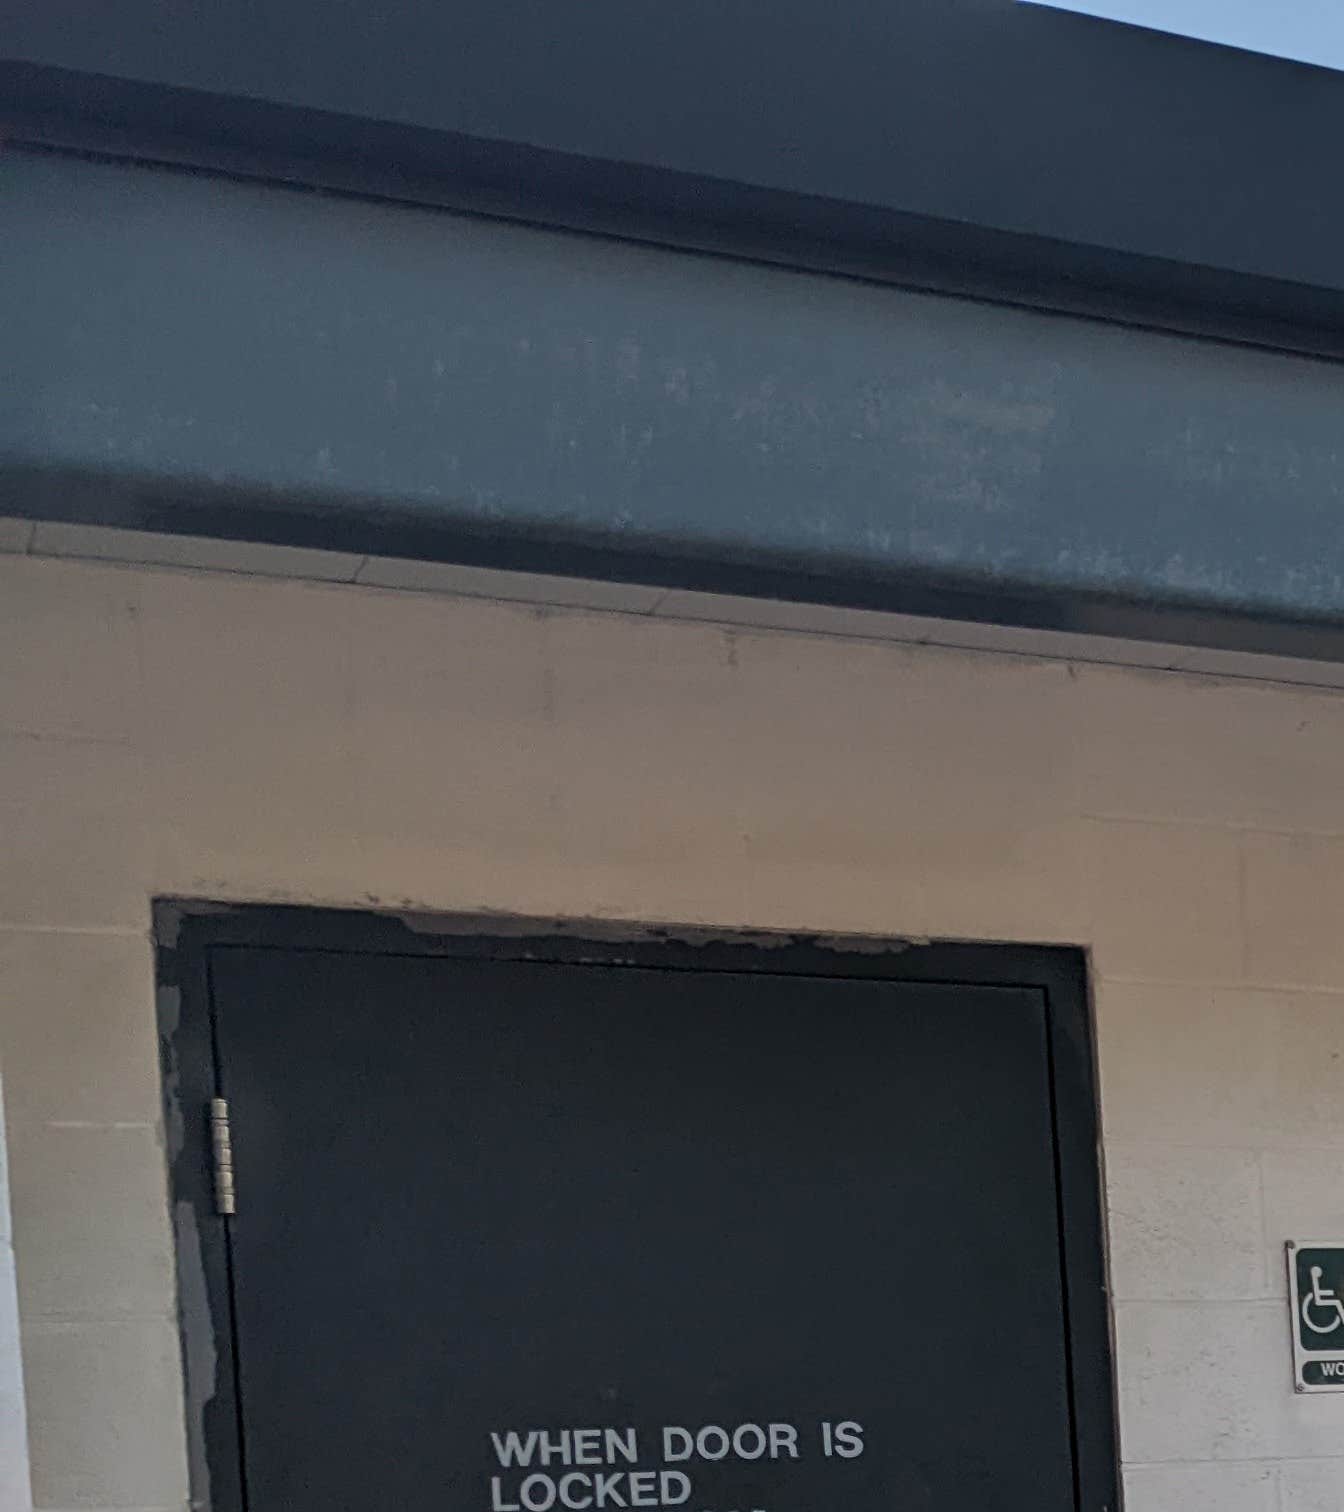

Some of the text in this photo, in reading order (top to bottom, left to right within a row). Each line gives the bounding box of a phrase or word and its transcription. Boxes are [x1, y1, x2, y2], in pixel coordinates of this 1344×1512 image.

[490, 1421, 865, 1467] WHEN DOOR IS
[490, 1470, 692, 1512] LOCKED
